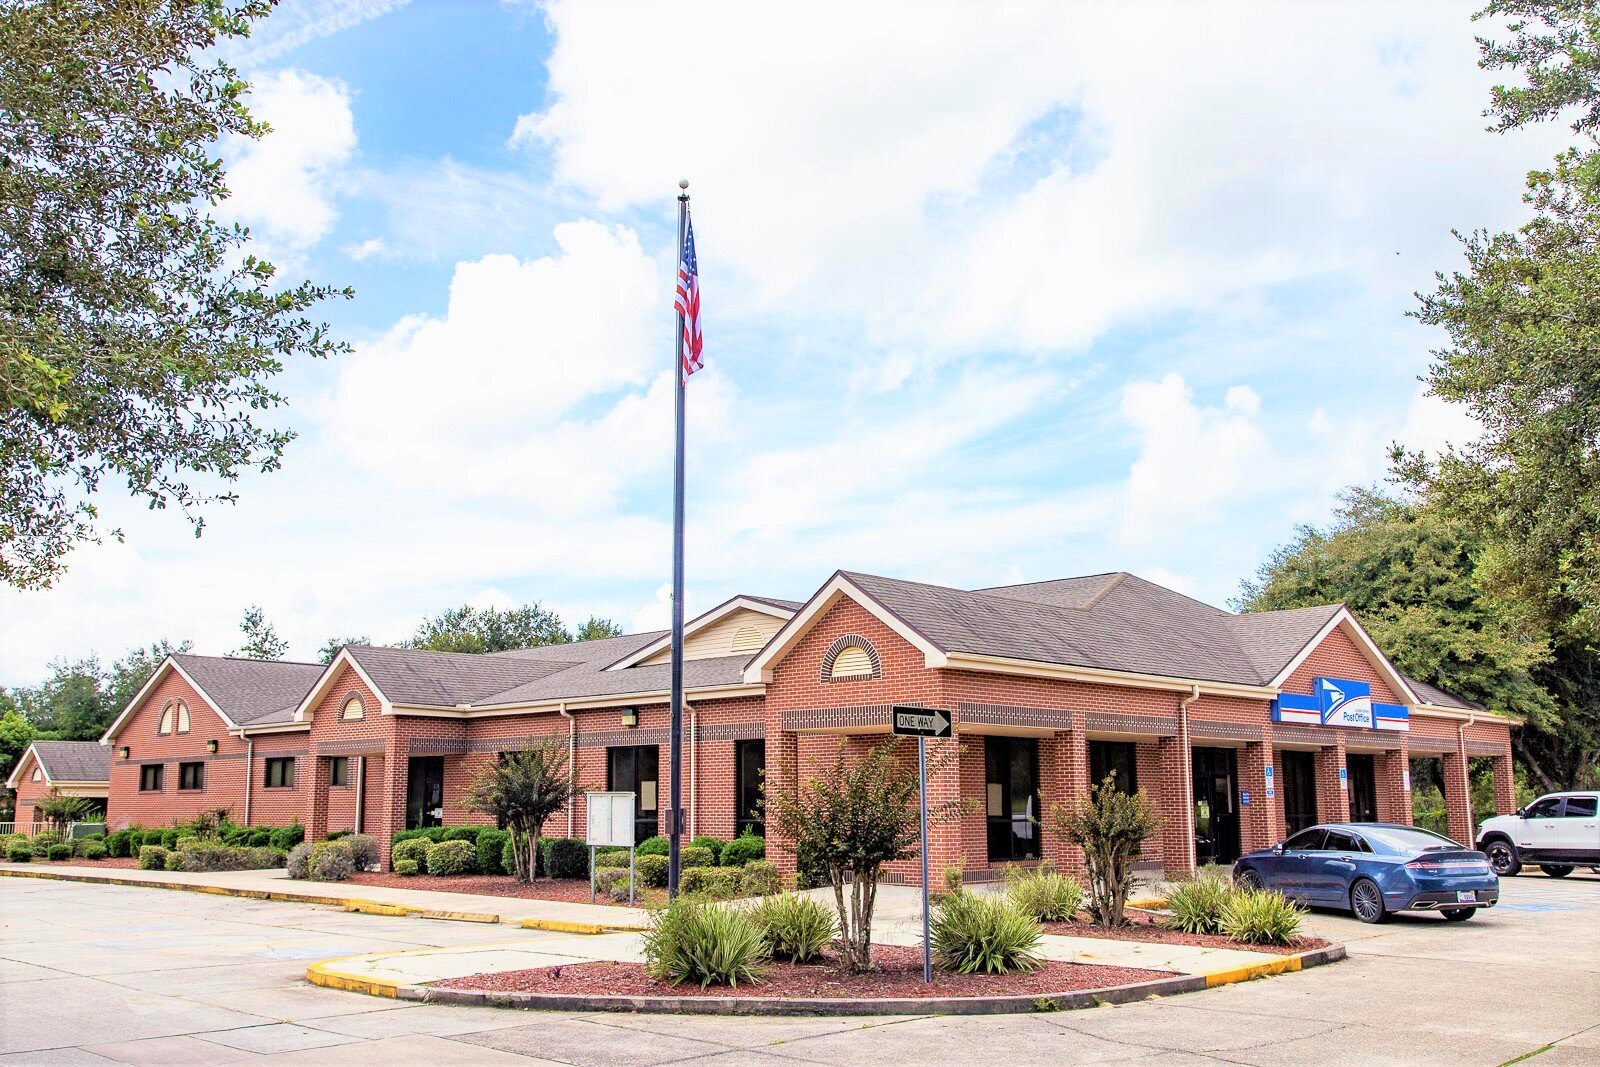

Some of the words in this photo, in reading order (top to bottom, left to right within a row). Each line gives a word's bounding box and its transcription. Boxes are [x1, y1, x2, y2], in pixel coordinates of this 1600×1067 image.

[899, 715, 915, 727] ONE
[918, 717, 934, 728] WAY
[1343, 711, 1354, 722] Post
[1355, 712, 1370, 723] Office
